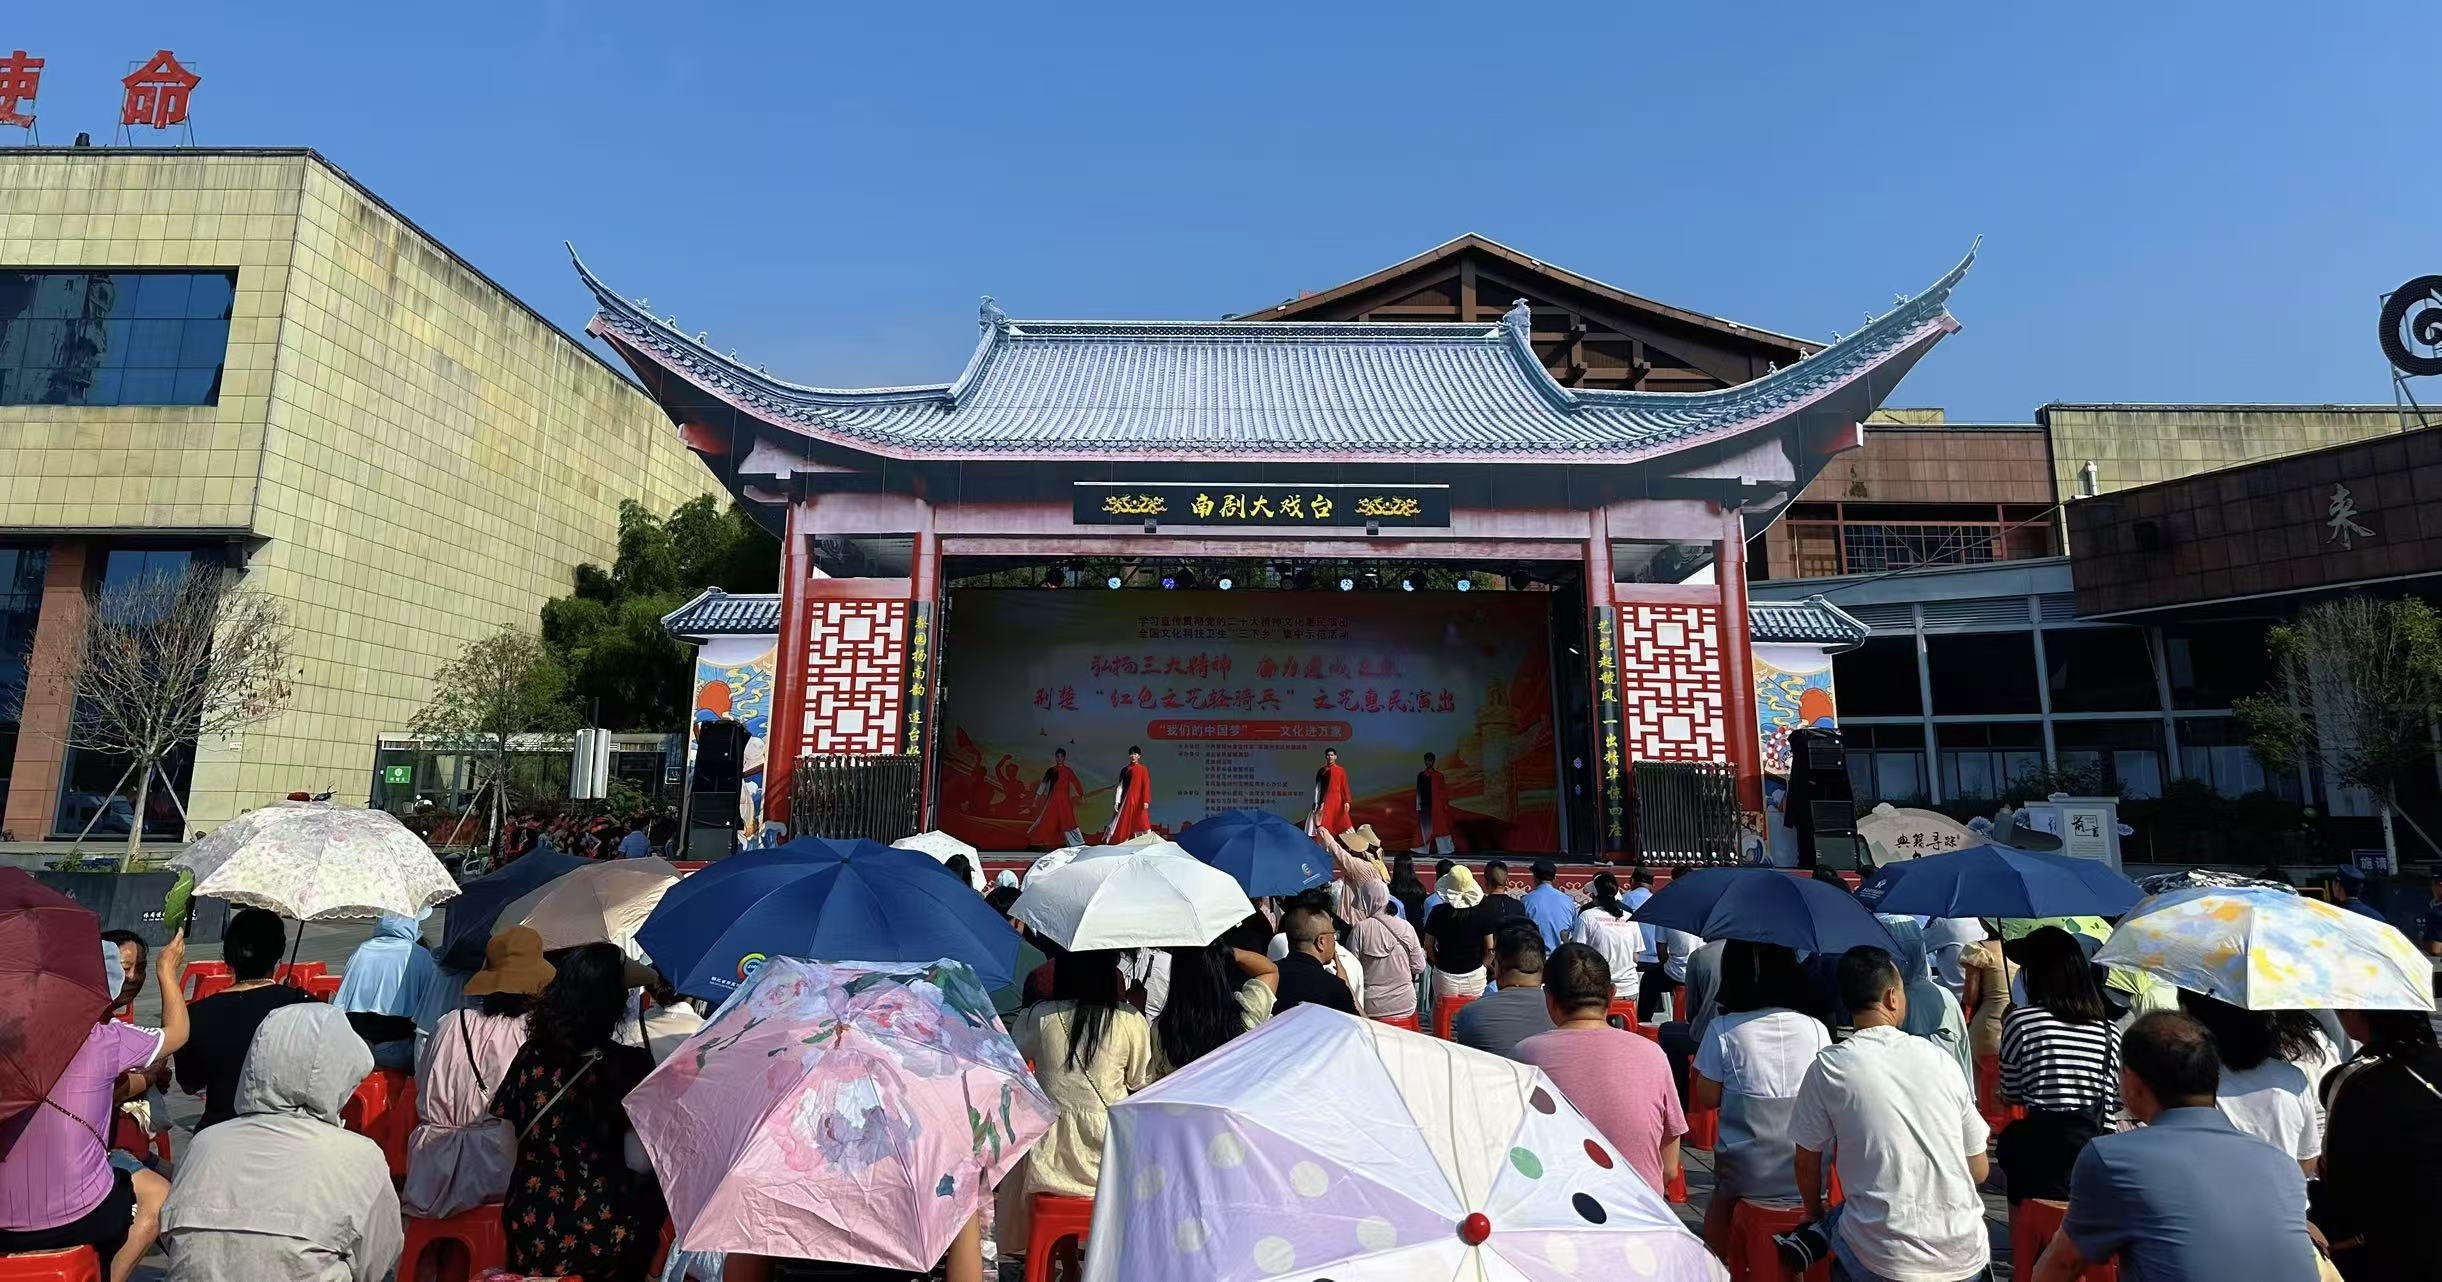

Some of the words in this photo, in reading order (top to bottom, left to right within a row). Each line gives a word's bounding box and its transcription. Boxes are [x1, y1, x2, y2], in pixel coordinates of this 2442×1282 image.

[0, 50, 202, 129] 使命
[1190, 493, 1334, 519] 南剧大戏台
[2326, 482, 2376, 550] 来
[908, 616, 929, 698] 梨园扬南韵
[1894, 832, 1957, 850] 典籍寻踪
[2071, 816, 2099, 837] 前言
